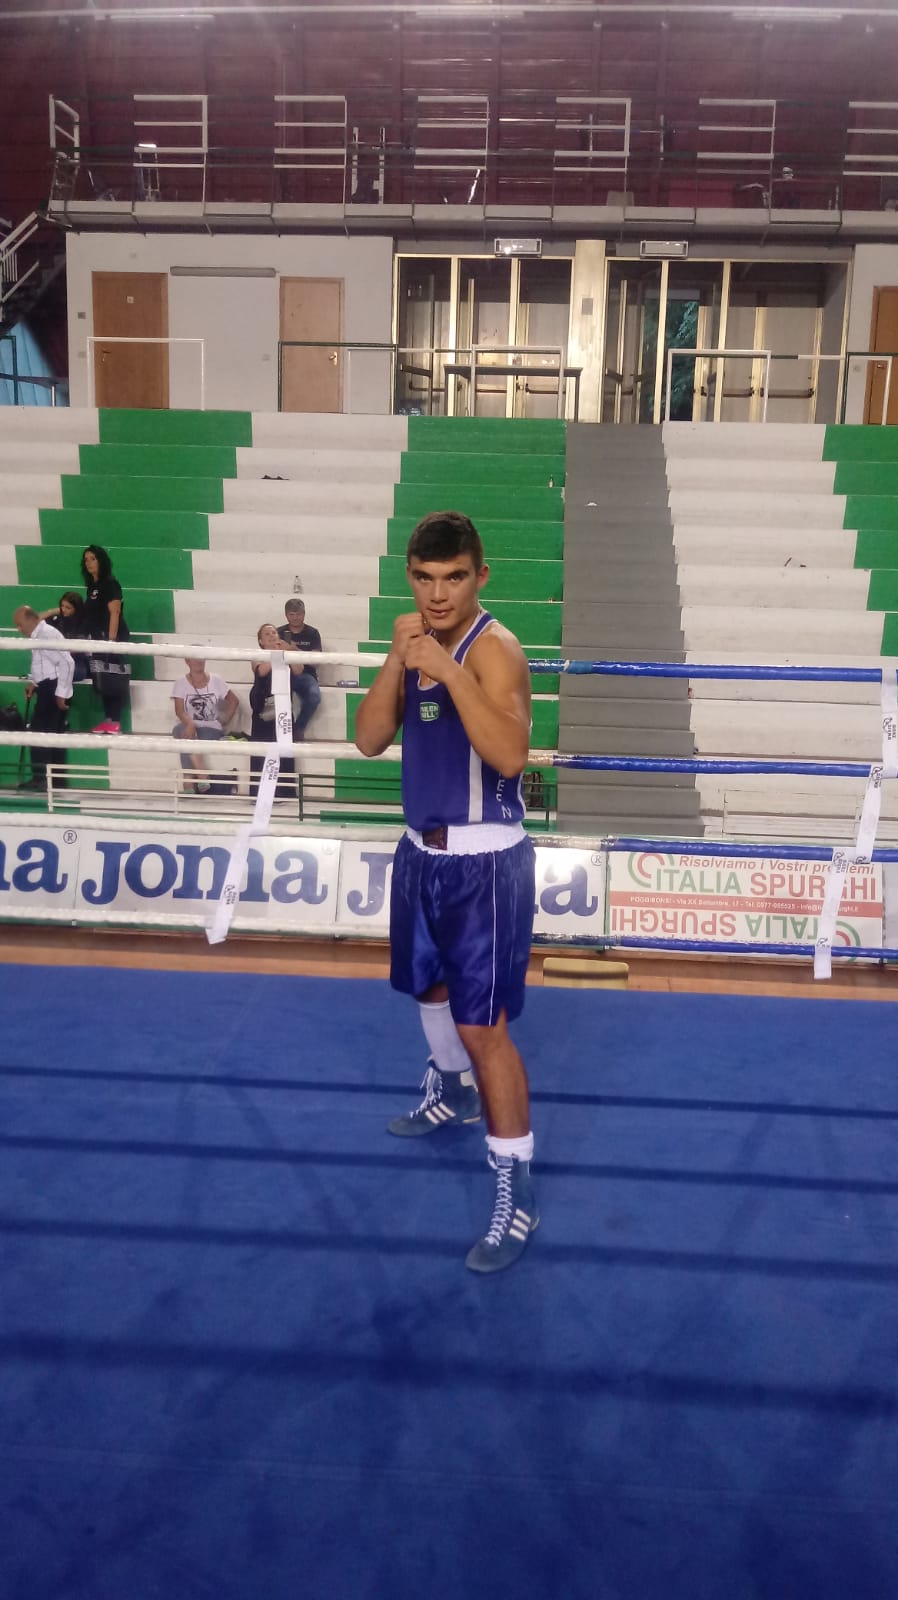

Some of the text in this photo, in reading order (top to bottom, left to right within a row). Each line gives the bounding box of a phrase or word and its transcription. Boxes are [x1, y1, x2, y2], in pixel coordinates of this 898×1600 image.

[679, 855, 756, 873] Risolviamo
[770, 859, 808, 873] Vostri
[656, 869, 876, 900] ITALIA SPURHI
[612, 908, 736, 936] SPURGHI
[745, 914, 820, 940] TALIA
